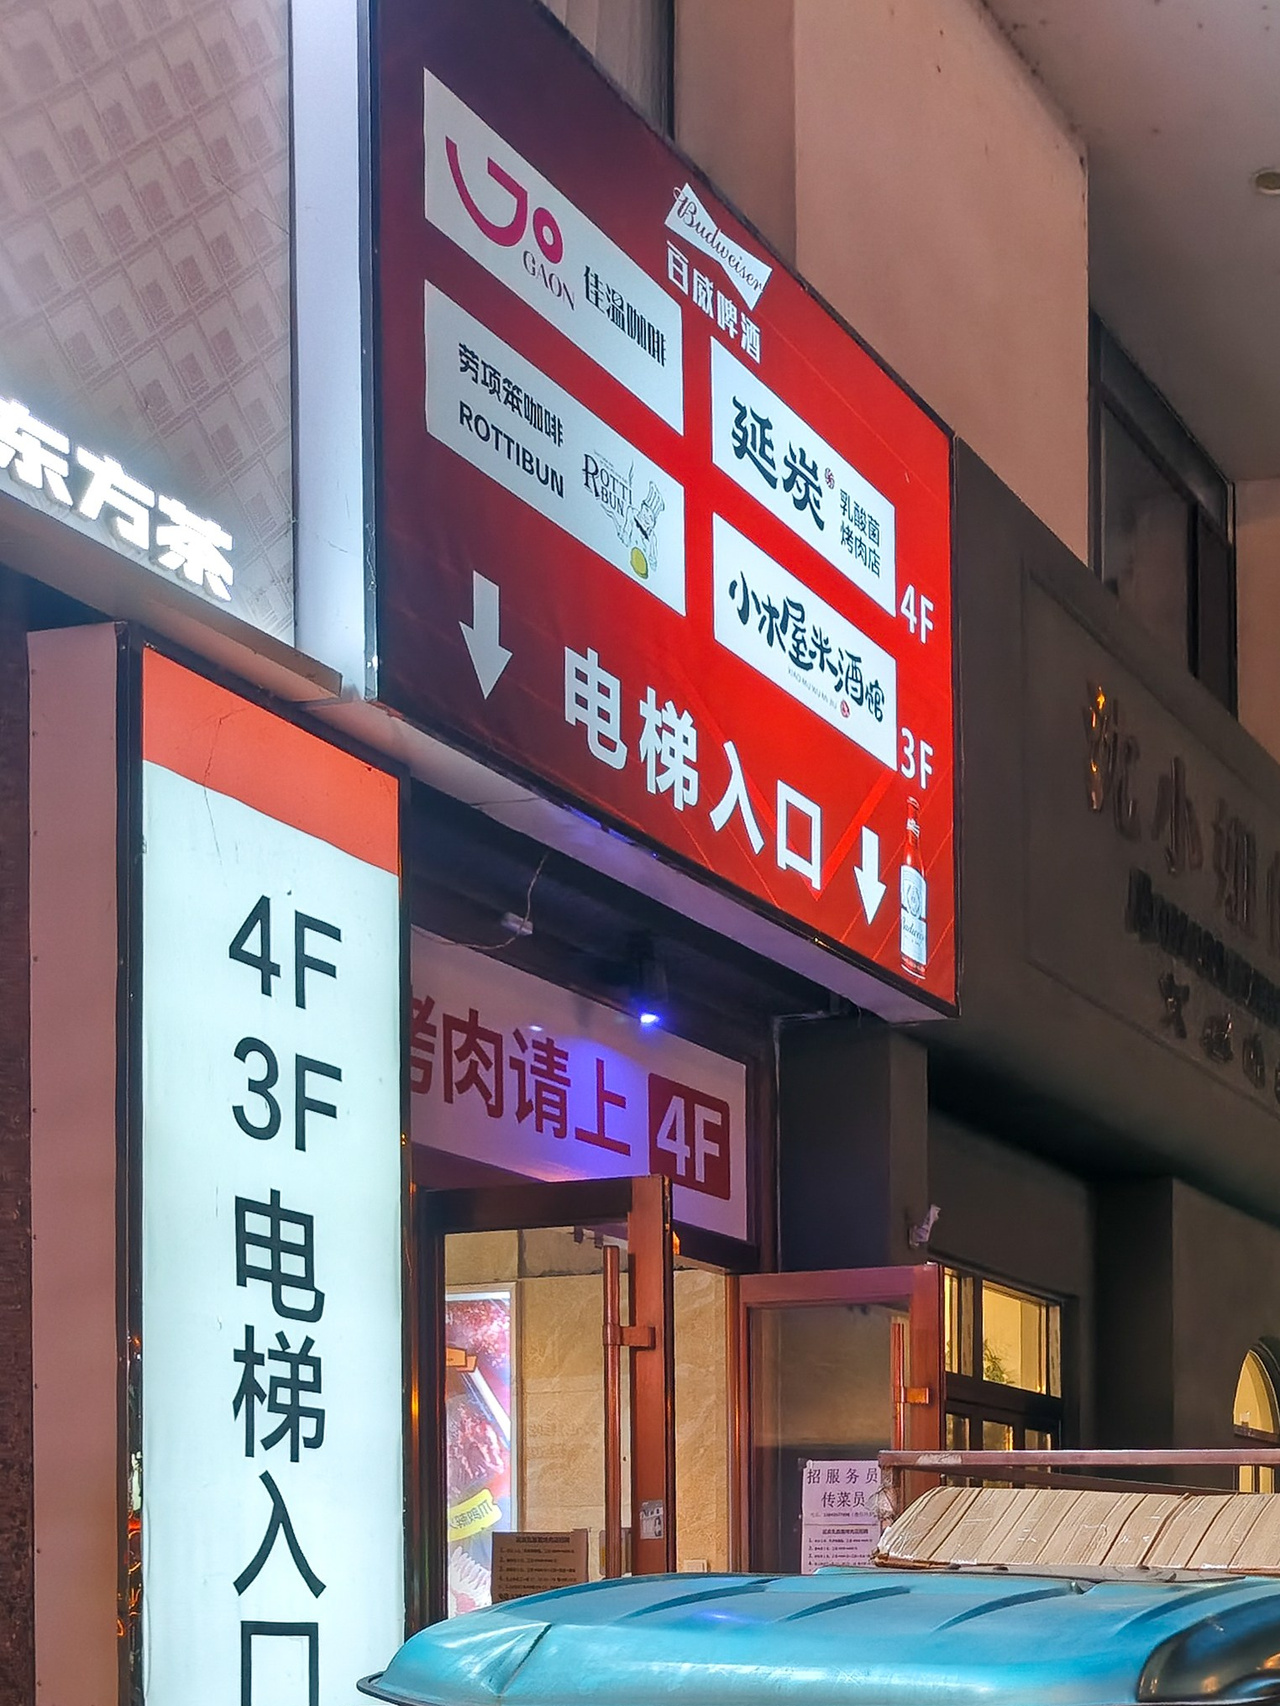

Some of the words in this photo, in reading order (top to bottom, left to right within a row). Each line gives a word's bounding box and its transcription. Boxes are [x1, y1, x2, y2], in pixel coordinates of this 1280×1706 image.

[523, 251, 575, 311] GAON
[673, 187, 763, 293] Budweiser
[667, 240, 761, 365] 百威啤酒
[459, 400, 564, 499] ROTTIBUN
[731, 395, 825, 531] 延炭
[839, 489, 880, 548] 乳酸菌
[840, 520, 881, 579] 烤肉店
[900, 584, 935, 645] 4F
[564, 646, 822, 891] 电梯入口
[901, 727, 935, 790] 3F
[228, 895, 342, 1010] 4F
[233, 1037, 342, 1152] 3F
[656, 1094, 722, 1183] 4F
[807, 1467, 878, 1485] 招服务员
[821, 1491, 866, 1508] 传菜员
